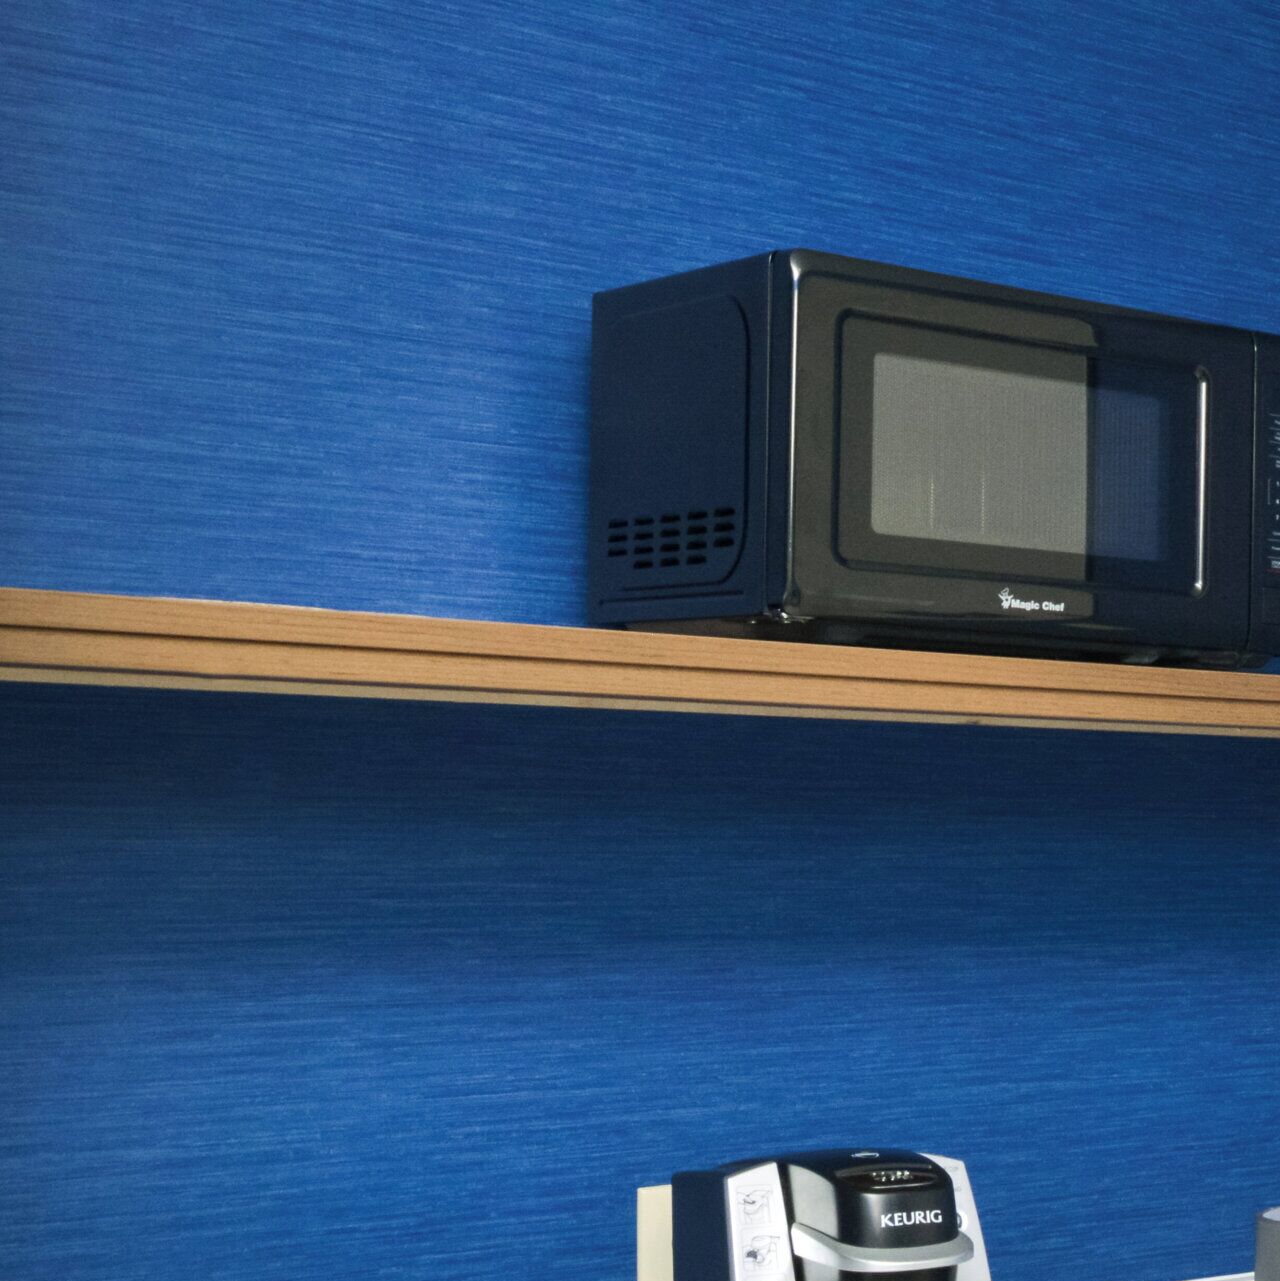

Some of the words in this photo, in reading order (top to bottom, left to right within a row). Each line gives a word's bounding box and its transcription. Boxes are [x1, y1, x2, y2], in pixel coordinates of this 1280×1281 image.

[1011, 599, 1040, 610] Magic
[1042, 601, 1064, 611] Chef
[881, 1210, 942, 1228] KEURIG
